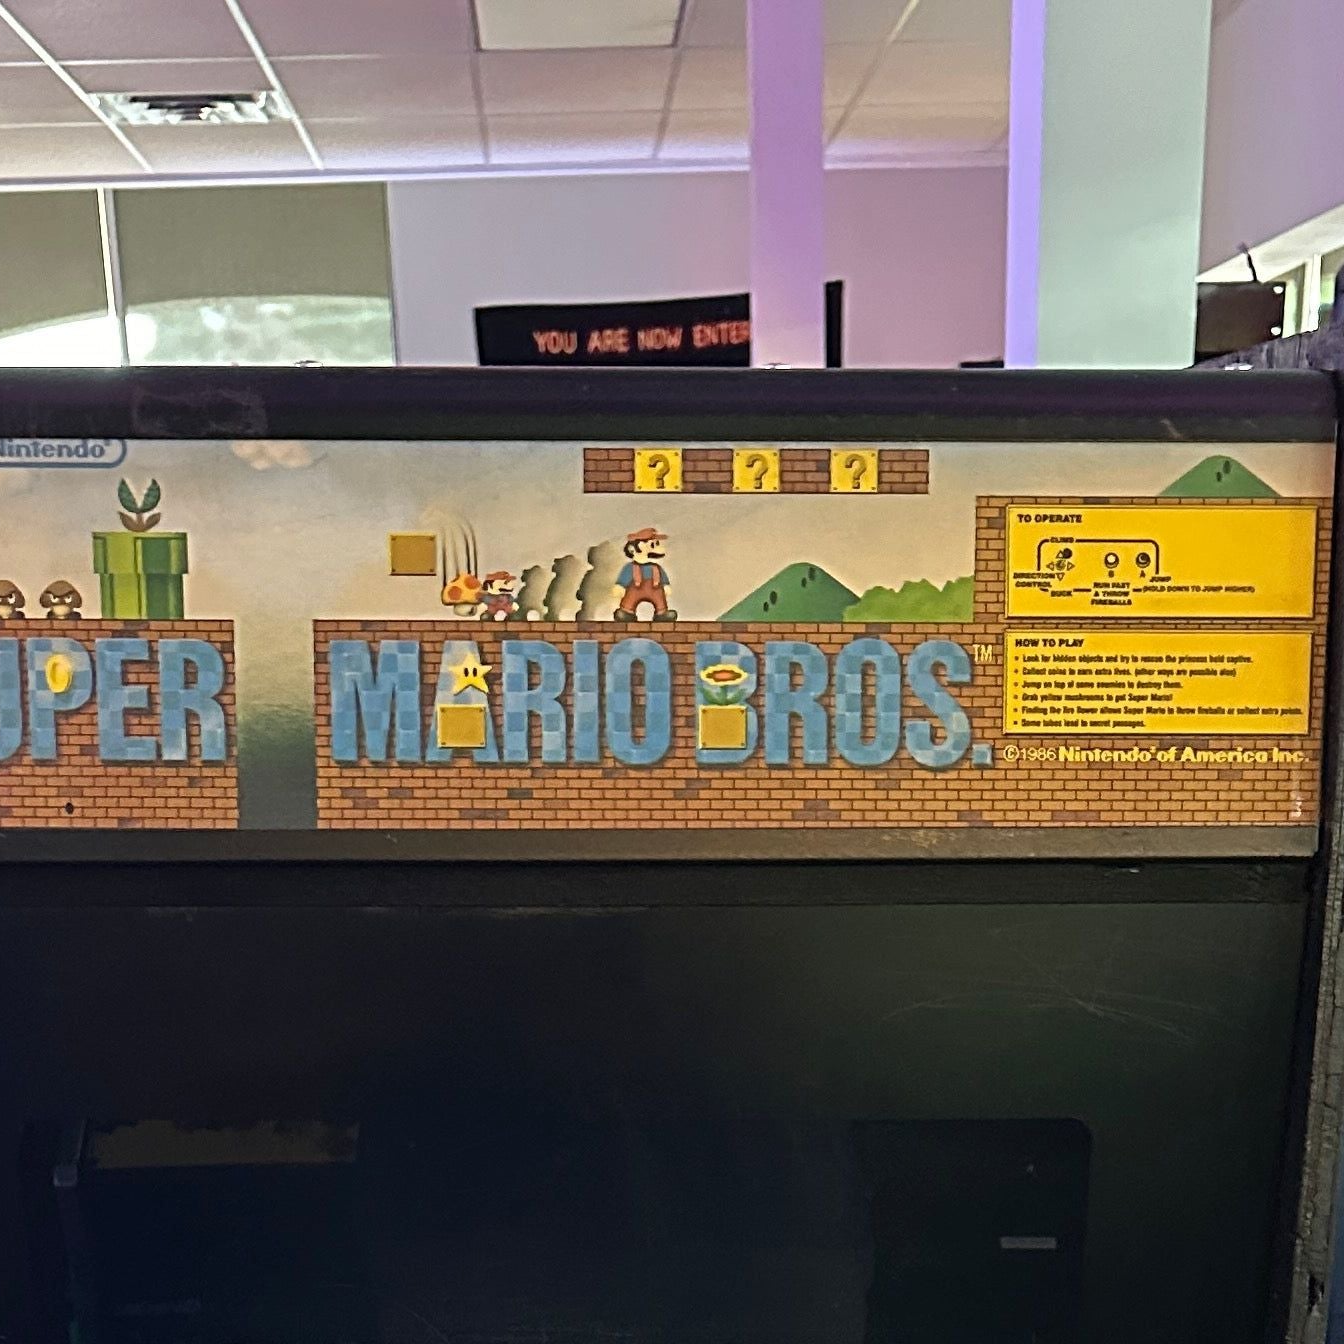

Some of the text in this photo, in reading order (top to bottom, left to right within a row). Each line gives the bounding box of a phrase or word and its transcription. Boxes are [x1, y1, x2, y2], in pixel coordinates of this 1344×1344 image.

[532, 330, 578, 354] YOU
[587, 328, 630, 353] ARE
[637, 327, 683, 351] NOW
[1017, 514, 1083, 523] TO OPERATE
[1015, 639, 1085, 648] HOW TO PLAY
[329, 637, 672, 766] MARIO
[695, 638, 993, 768] BROS.
[1004, 744, 1057, 762] ©1986
[1157, 746, 1178, 762] of
[1180, 746, 1269, 763] America
[1272, 746, 1310, 763] Inc.
